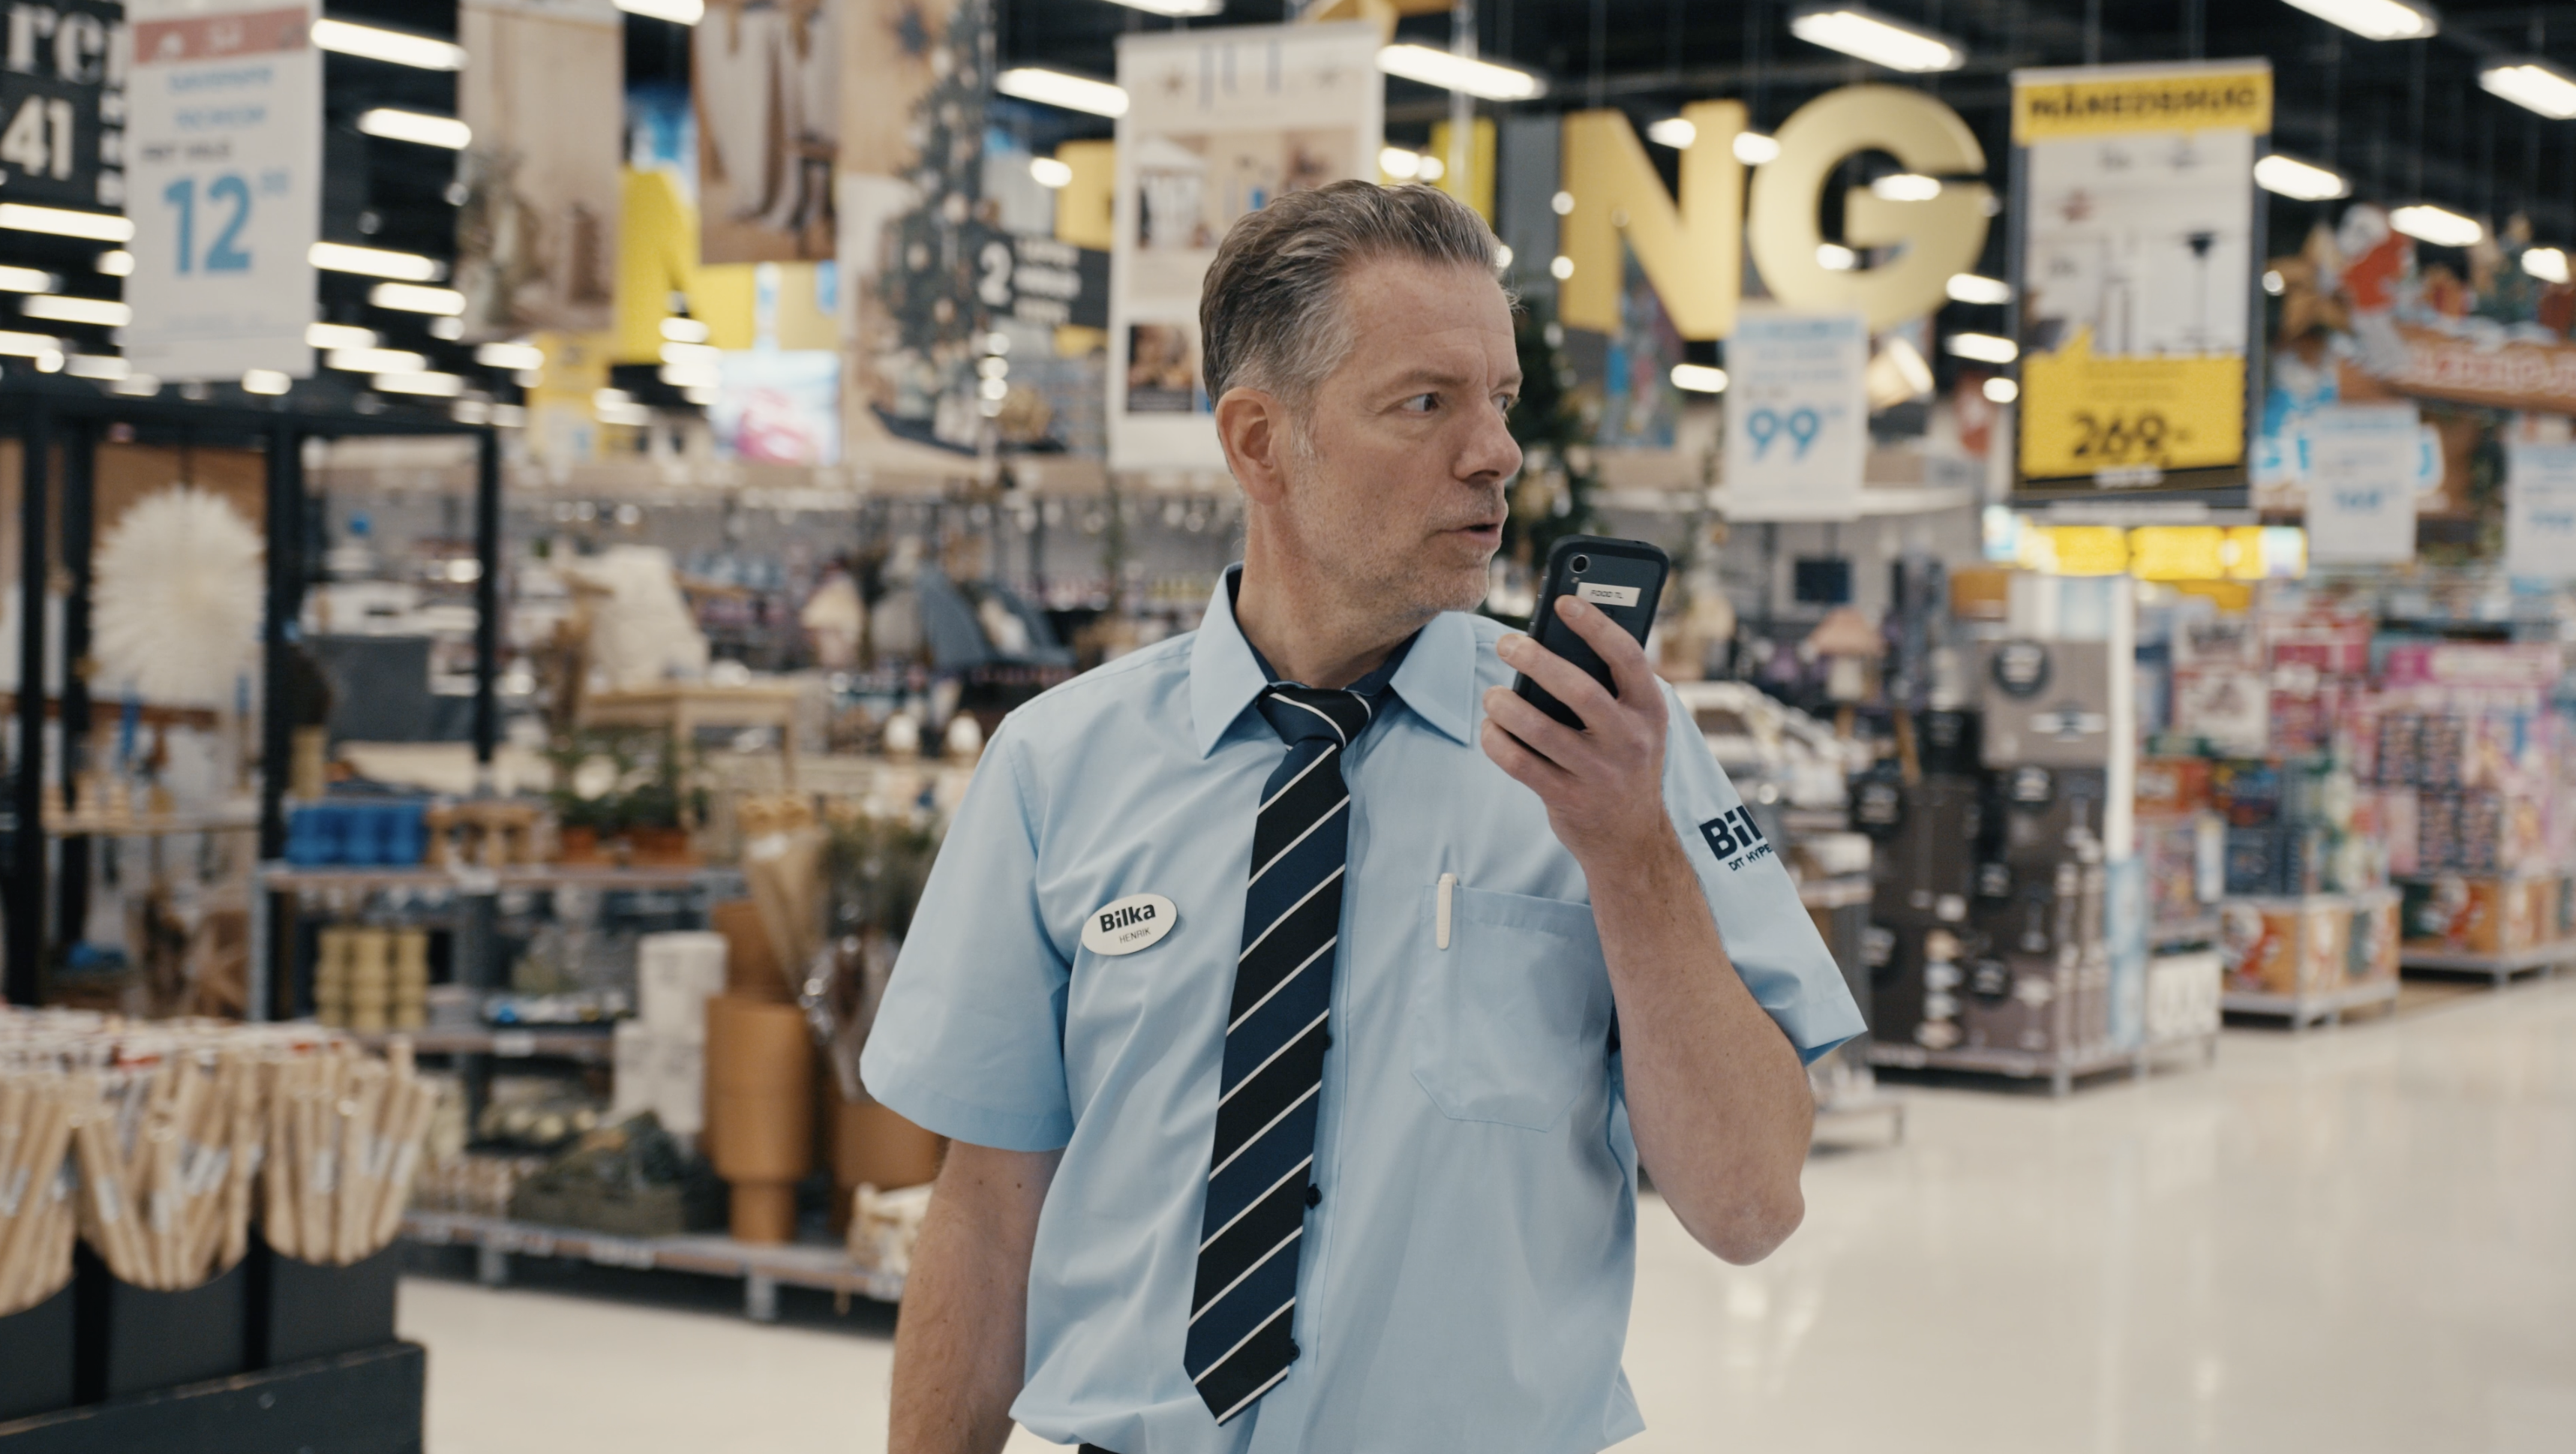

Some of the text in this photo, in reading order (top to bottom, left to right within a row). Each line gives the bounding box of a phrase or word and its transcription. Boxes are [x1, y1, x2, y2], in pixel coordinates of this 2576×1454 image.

[163, 173, 253, 277] 12
[1560, 84, 1990, 341] NG
[1746, 407, 1821, 464] 99
[1728, 857, 1745, 871] DIT
[1100, 904, 1156, 933] Bilka
[1119, 927, 1151, 944] HENRIK
